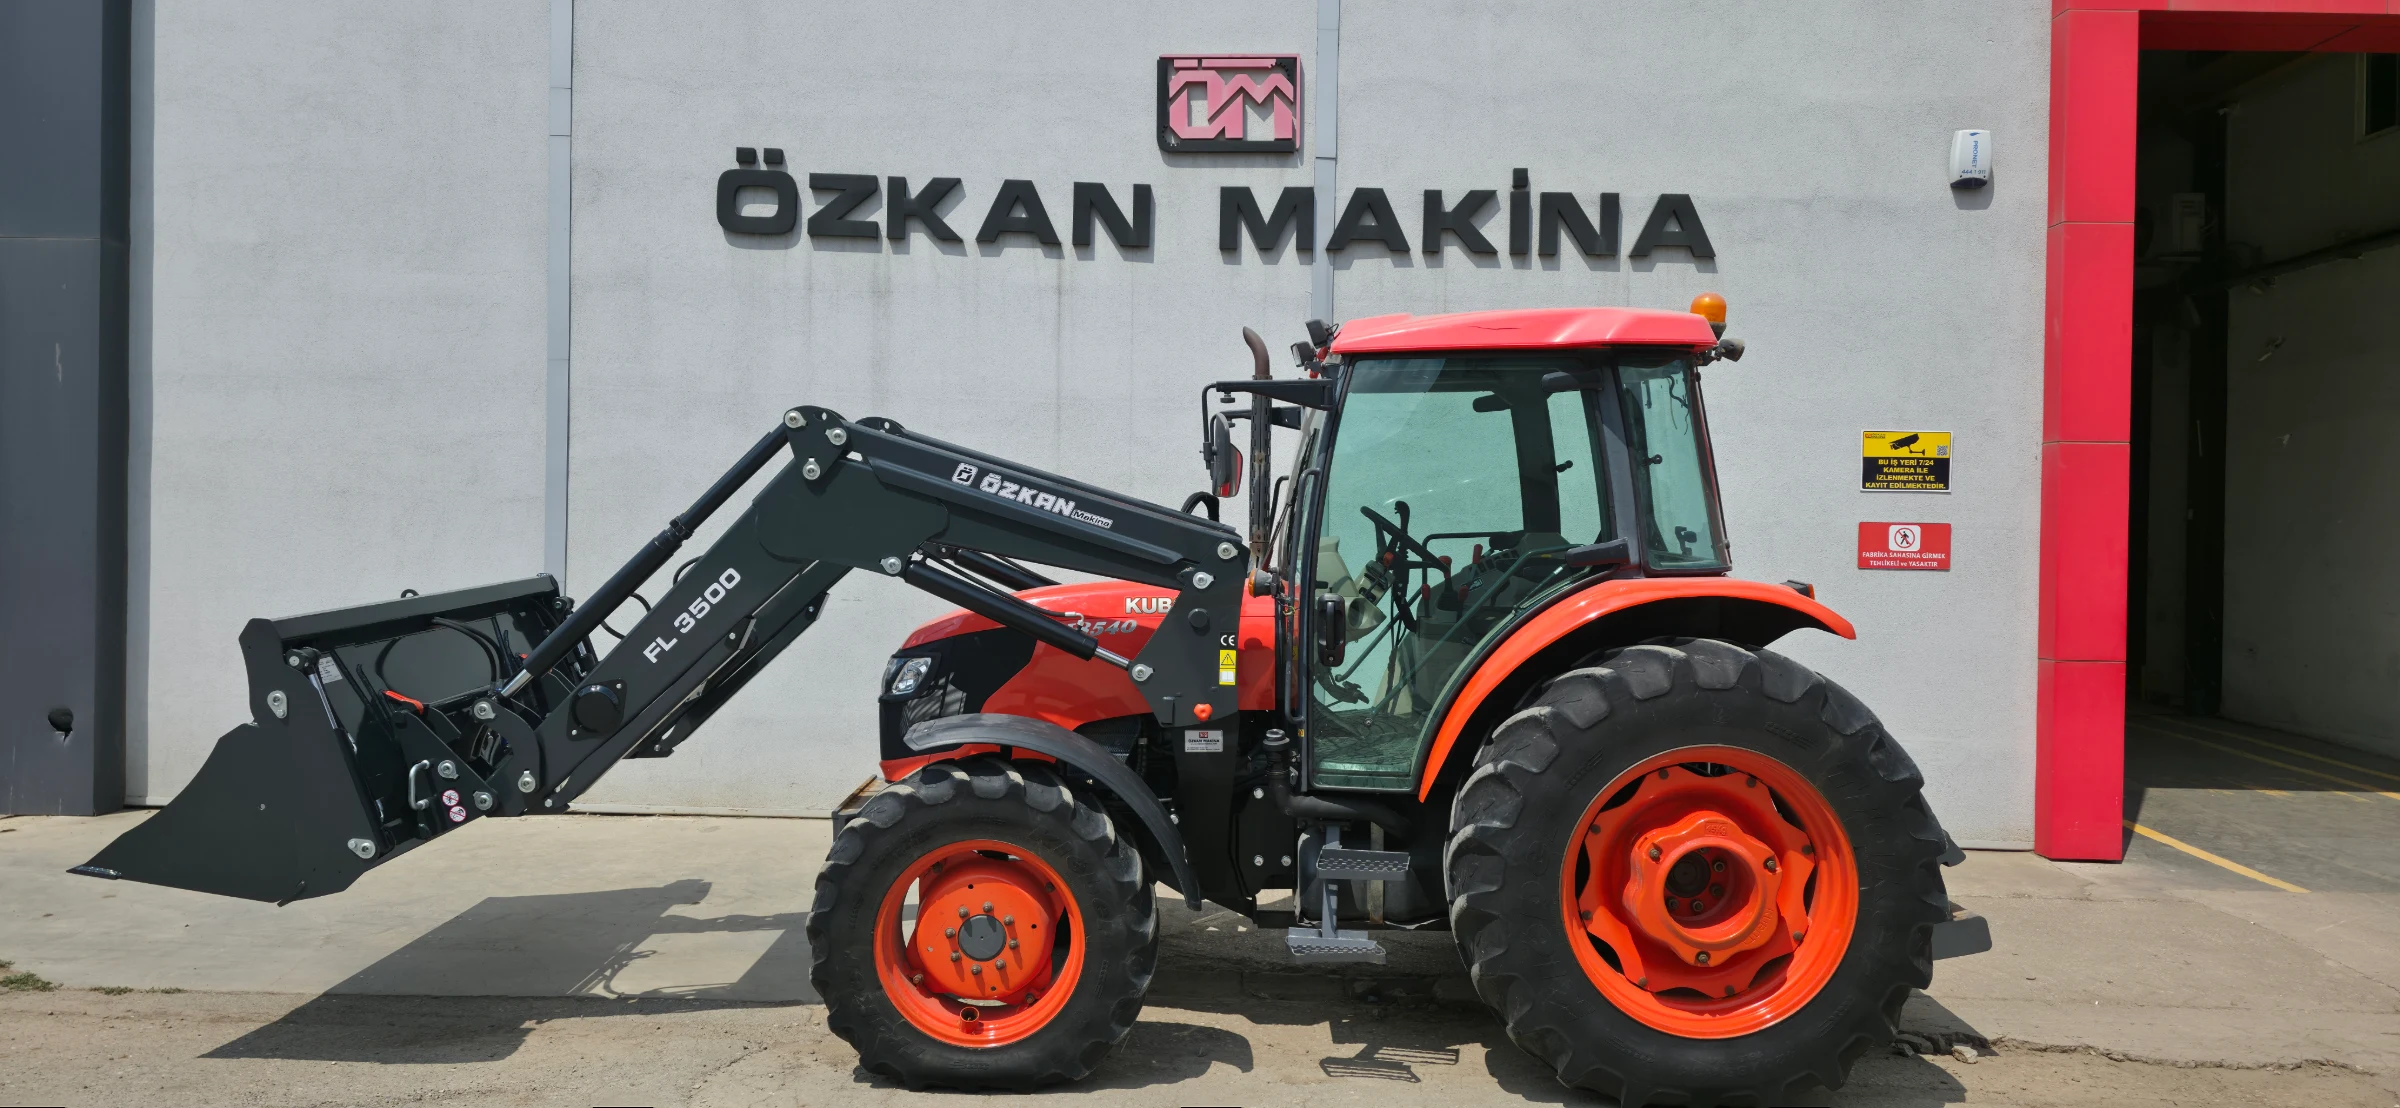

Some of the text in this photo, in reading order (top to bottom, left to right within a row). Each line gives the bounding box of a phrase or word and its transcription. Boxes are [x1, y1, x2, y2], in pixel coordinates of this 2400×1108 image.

[716, 147, 1716, 258] ÖZKAN MAKİNA
[1890, 458, 1898, 466] İŞ
[1900, 458, 1917, 466] YERİ
[979, 473, 1076, 517] ÖZKAN
[1072, 510, 1112, 528] Makina
[1870, 559, 1899, 567] TEHLİKELİ
[1125, 597, 1176, 614] KUB
[643, 567, 741, 664] FL 3500
[1068, 620, 1138, 636] 8540
